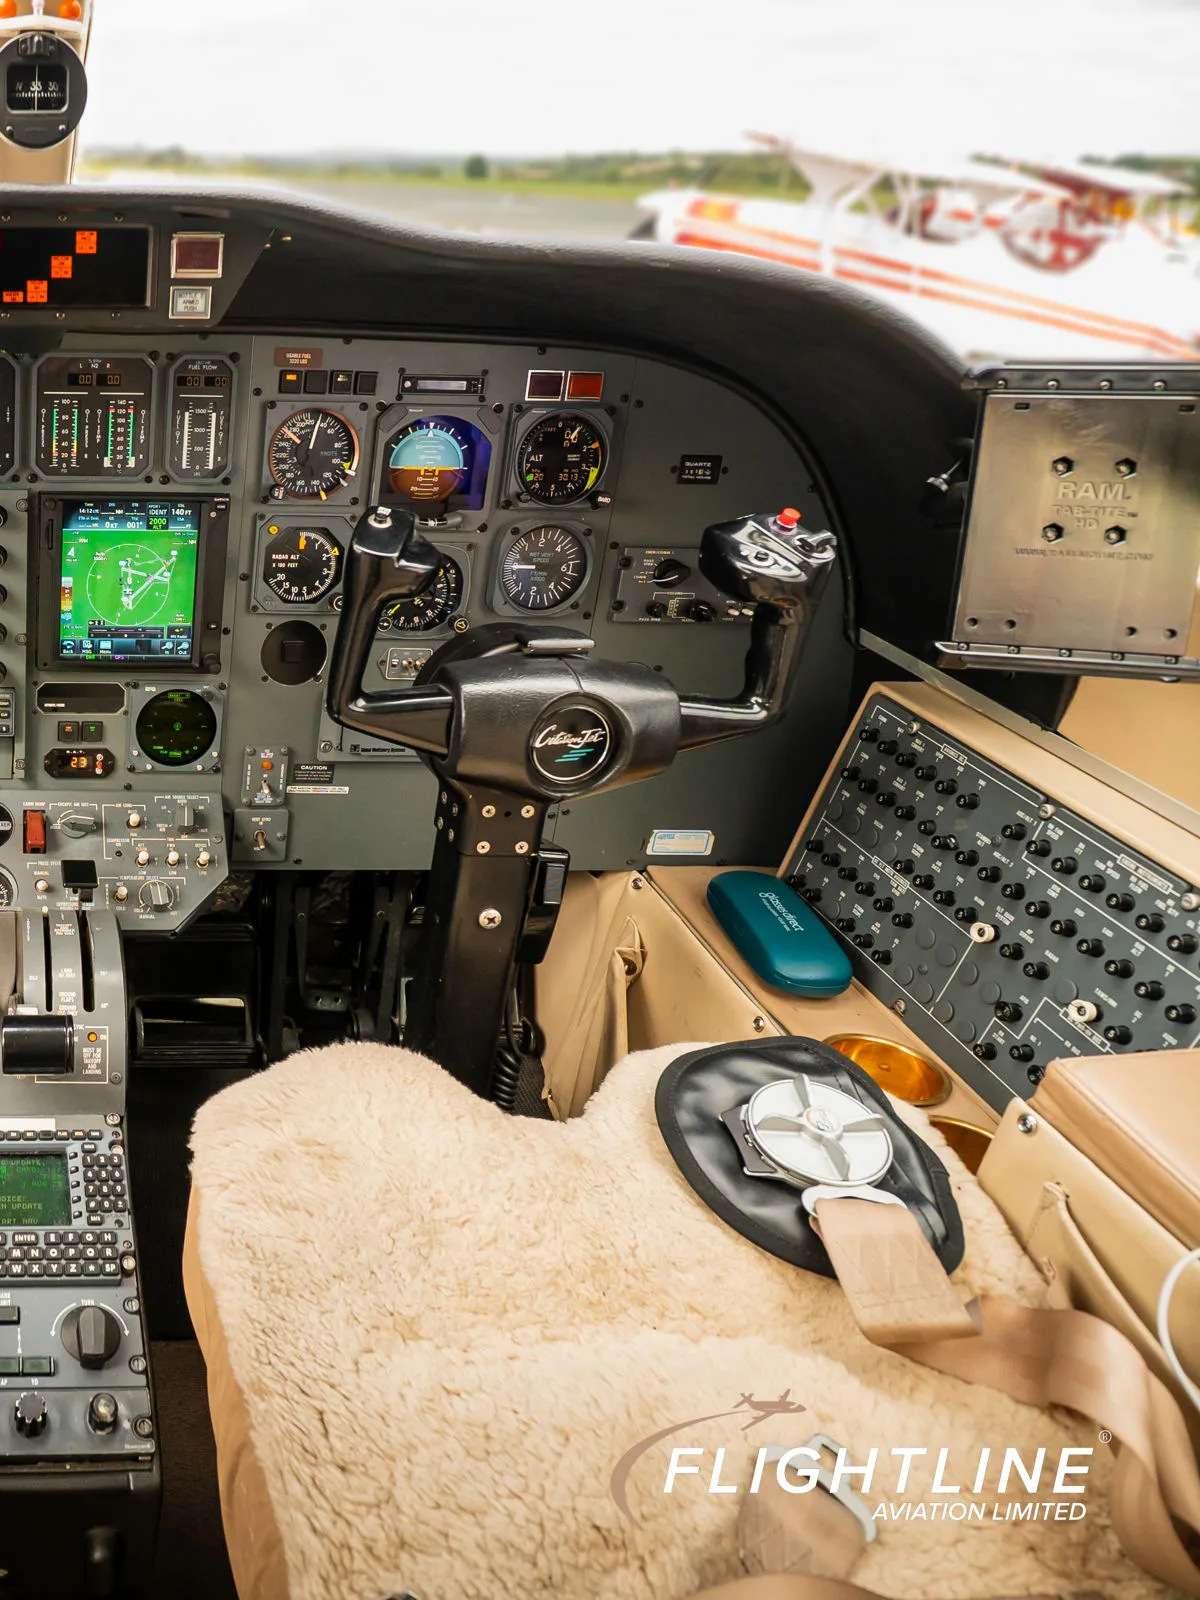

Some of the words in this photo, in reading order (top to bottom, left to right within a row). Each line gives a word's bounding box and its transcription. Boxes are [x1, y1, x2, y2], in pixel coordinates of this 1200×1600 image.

[1057, 480, 1126, 501] RAM
[539, 538, 545, 546] 2
[561, 563, 567, 571] 6
[70, 757, 87, 768] 23
[12, 1265, 21, 1273] W
[32, 1265, 39, 1273] X
[51, 1264, 58, 1272] Y
[70, 1264, 76, 1272] Z
[105, 1263, 116, 1272] SP
